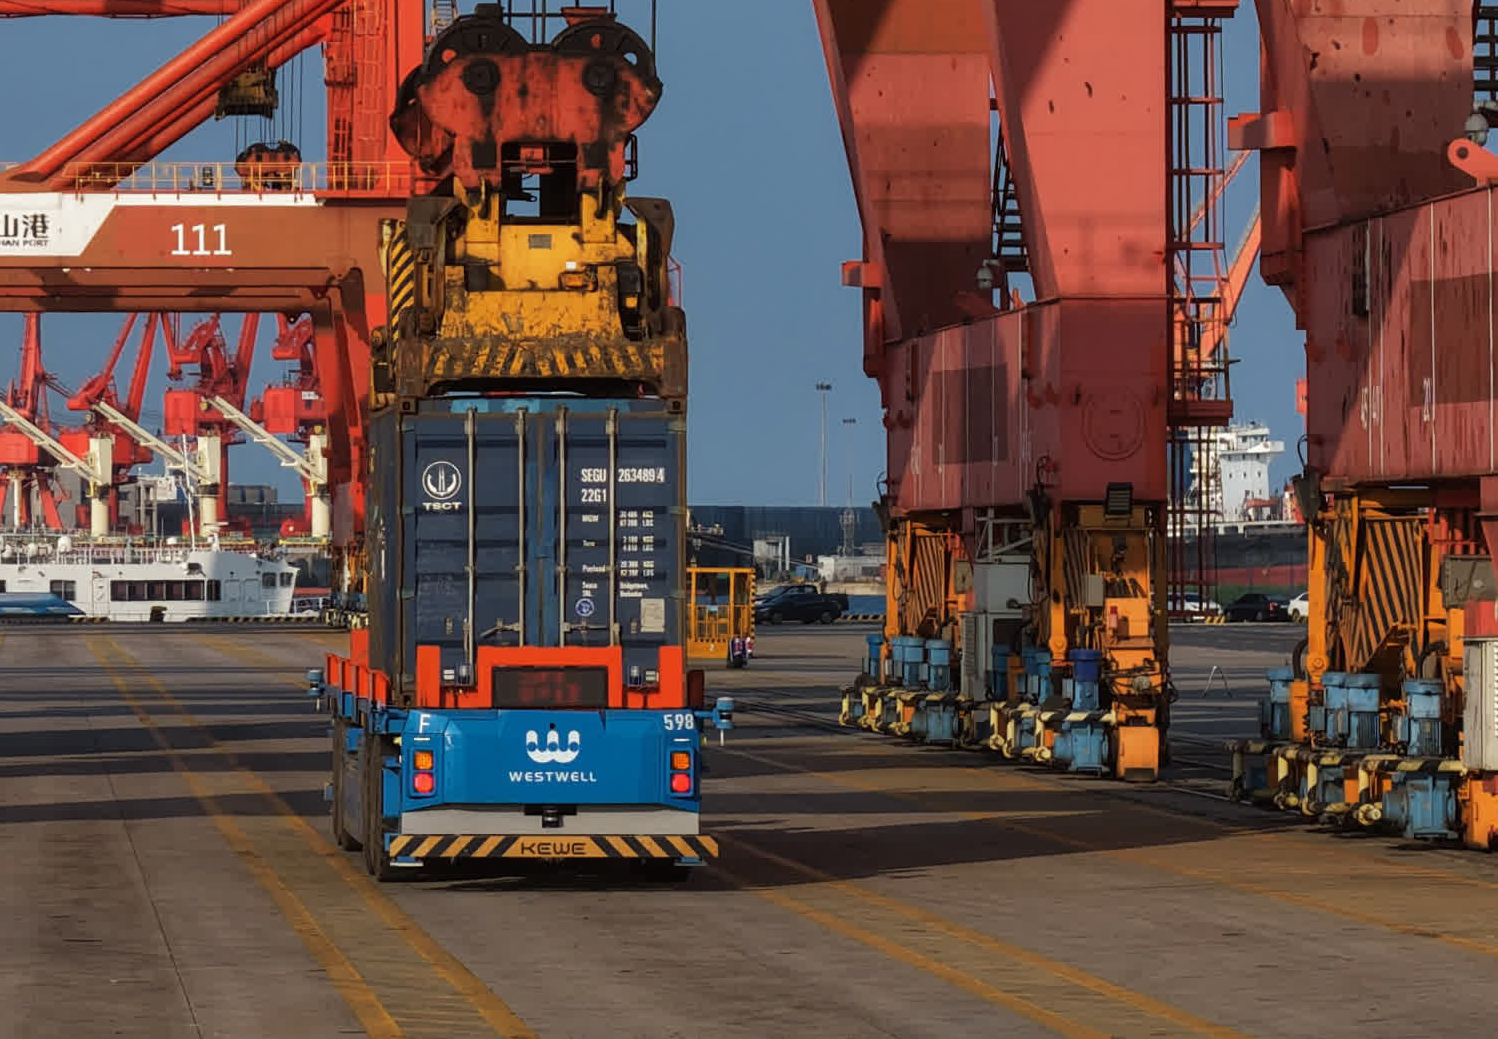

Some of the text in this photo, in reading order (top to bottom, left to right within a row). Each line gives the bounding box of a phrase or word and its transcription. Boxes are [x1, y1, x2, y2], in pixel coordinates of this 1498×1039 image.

[172, 224, 231, 255] 111
[582, 468, 606, 482] SEGU
[582, 488, 606, 502] 22G1
[422, 502, 462, 510] TSCT
[419, 713, 431, 733] F
[664, 714, 694, 730] 598
[509, 772, 596, 782] WESTWELL
[521, 842, 586, 855] KEWE
